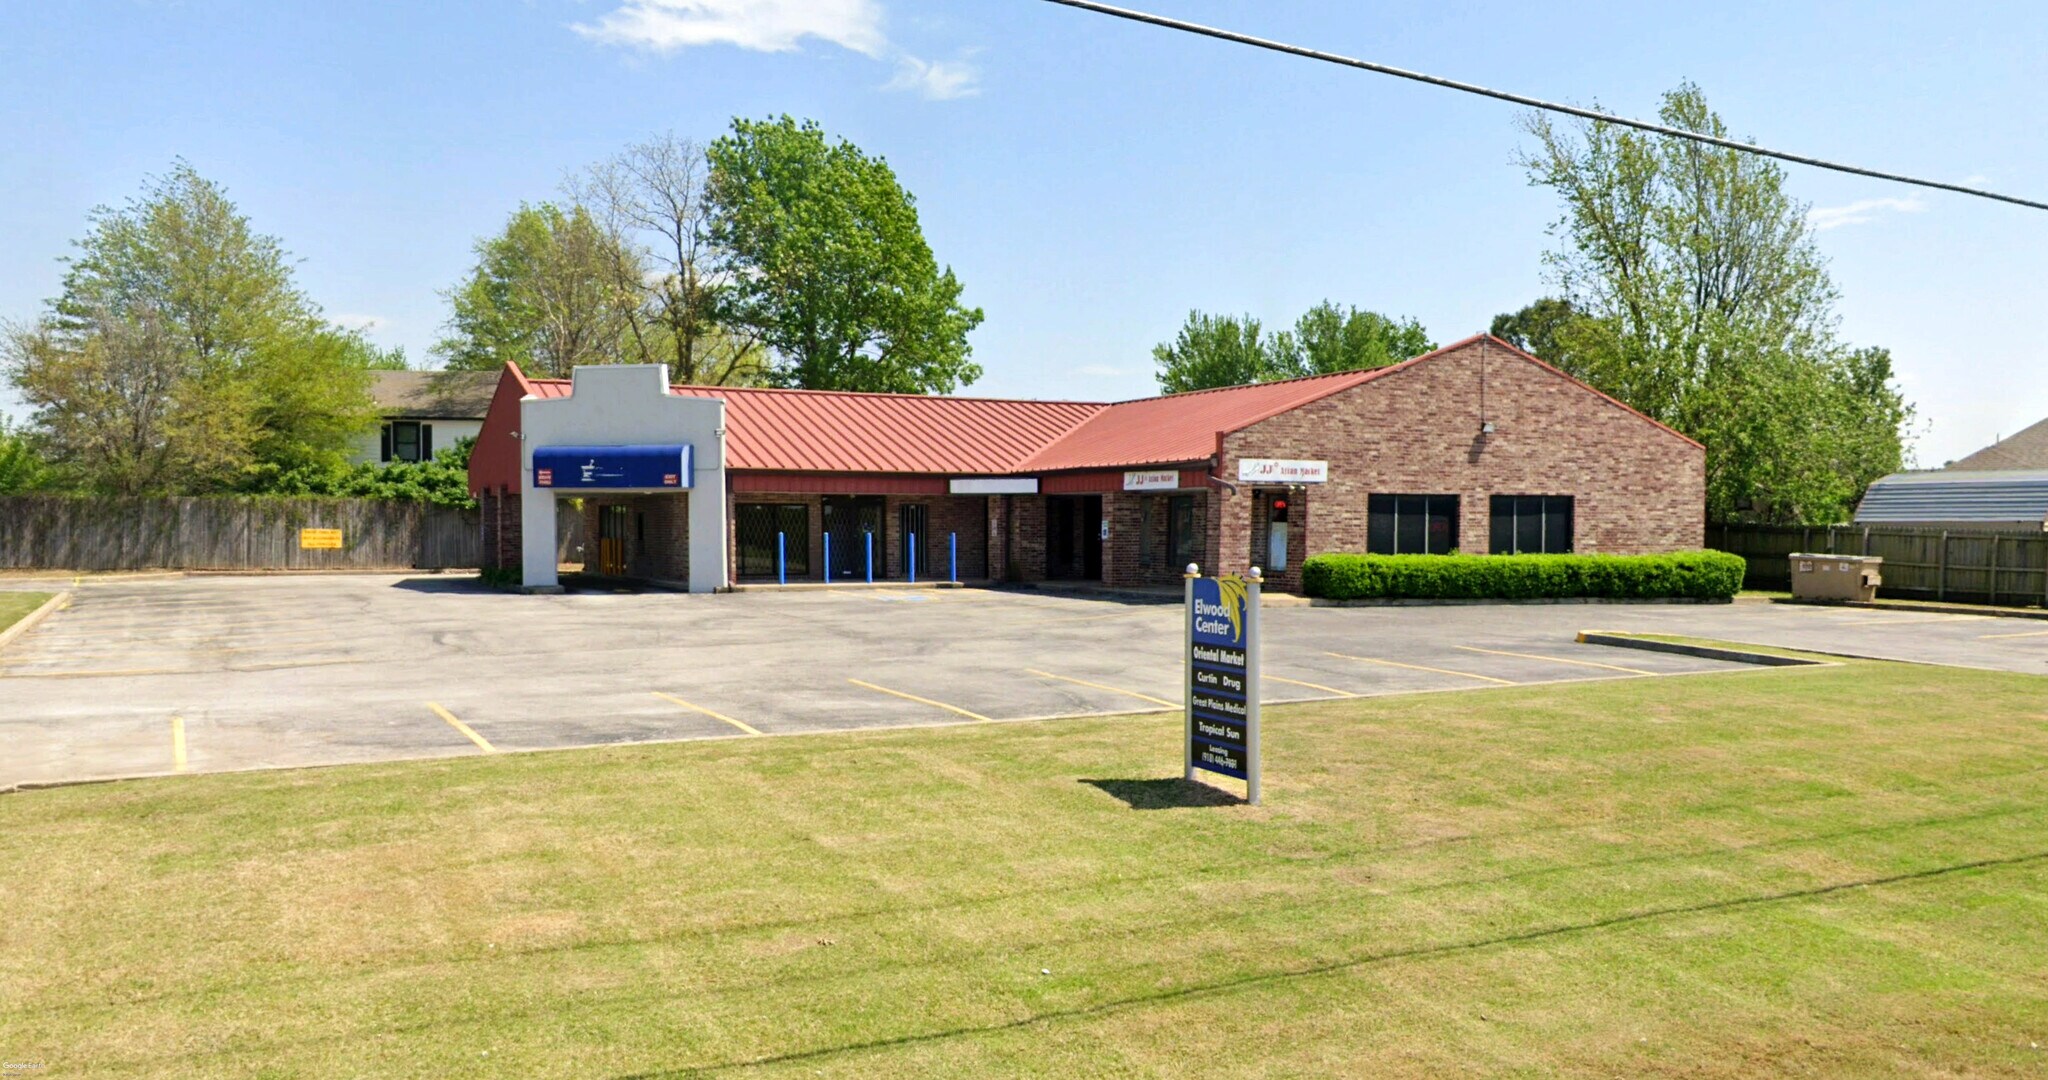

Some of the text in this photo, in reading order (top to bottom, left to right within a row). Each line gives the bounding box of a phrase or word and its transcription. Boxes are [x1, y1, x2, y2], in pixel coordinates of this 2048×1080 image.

[1195, 598, 1230, 617] Elwood
[1196, 616, 1229, 635] Center
[1193, 646, 1244, 666] Oriental Market
[1198, 671, 1240, 690] Curtin Drug
[1192, 695, 1247, 715] Great Plains Medical
[1199, 721, 1240, 740] Tropical Sun
[1209, 744, 1228, 757] Leasing
